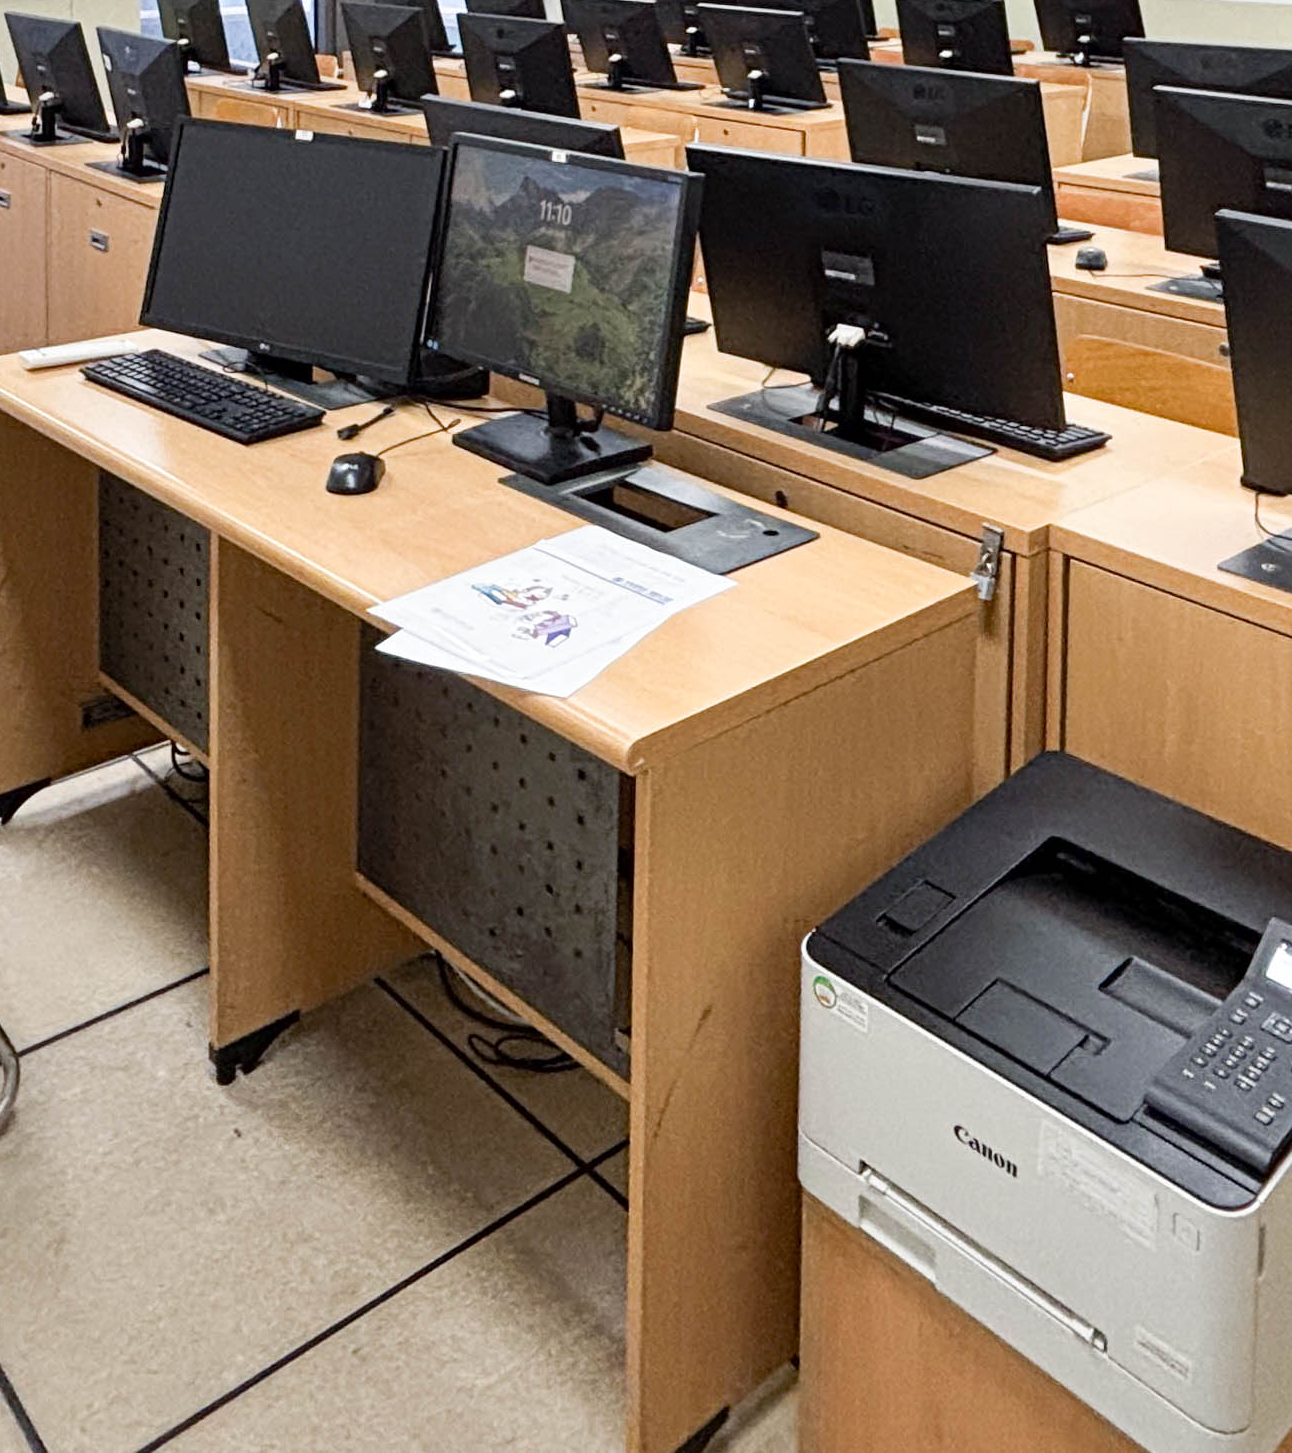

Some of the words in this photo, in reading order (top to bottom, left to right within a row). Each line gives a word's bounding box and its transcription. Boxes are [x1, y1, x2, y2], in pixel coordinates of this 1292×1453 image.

[540, 199, 573, 226] 11:10
[845, 194, 875, 215] LG
[953, 1125, 1018, 1178] Canon
